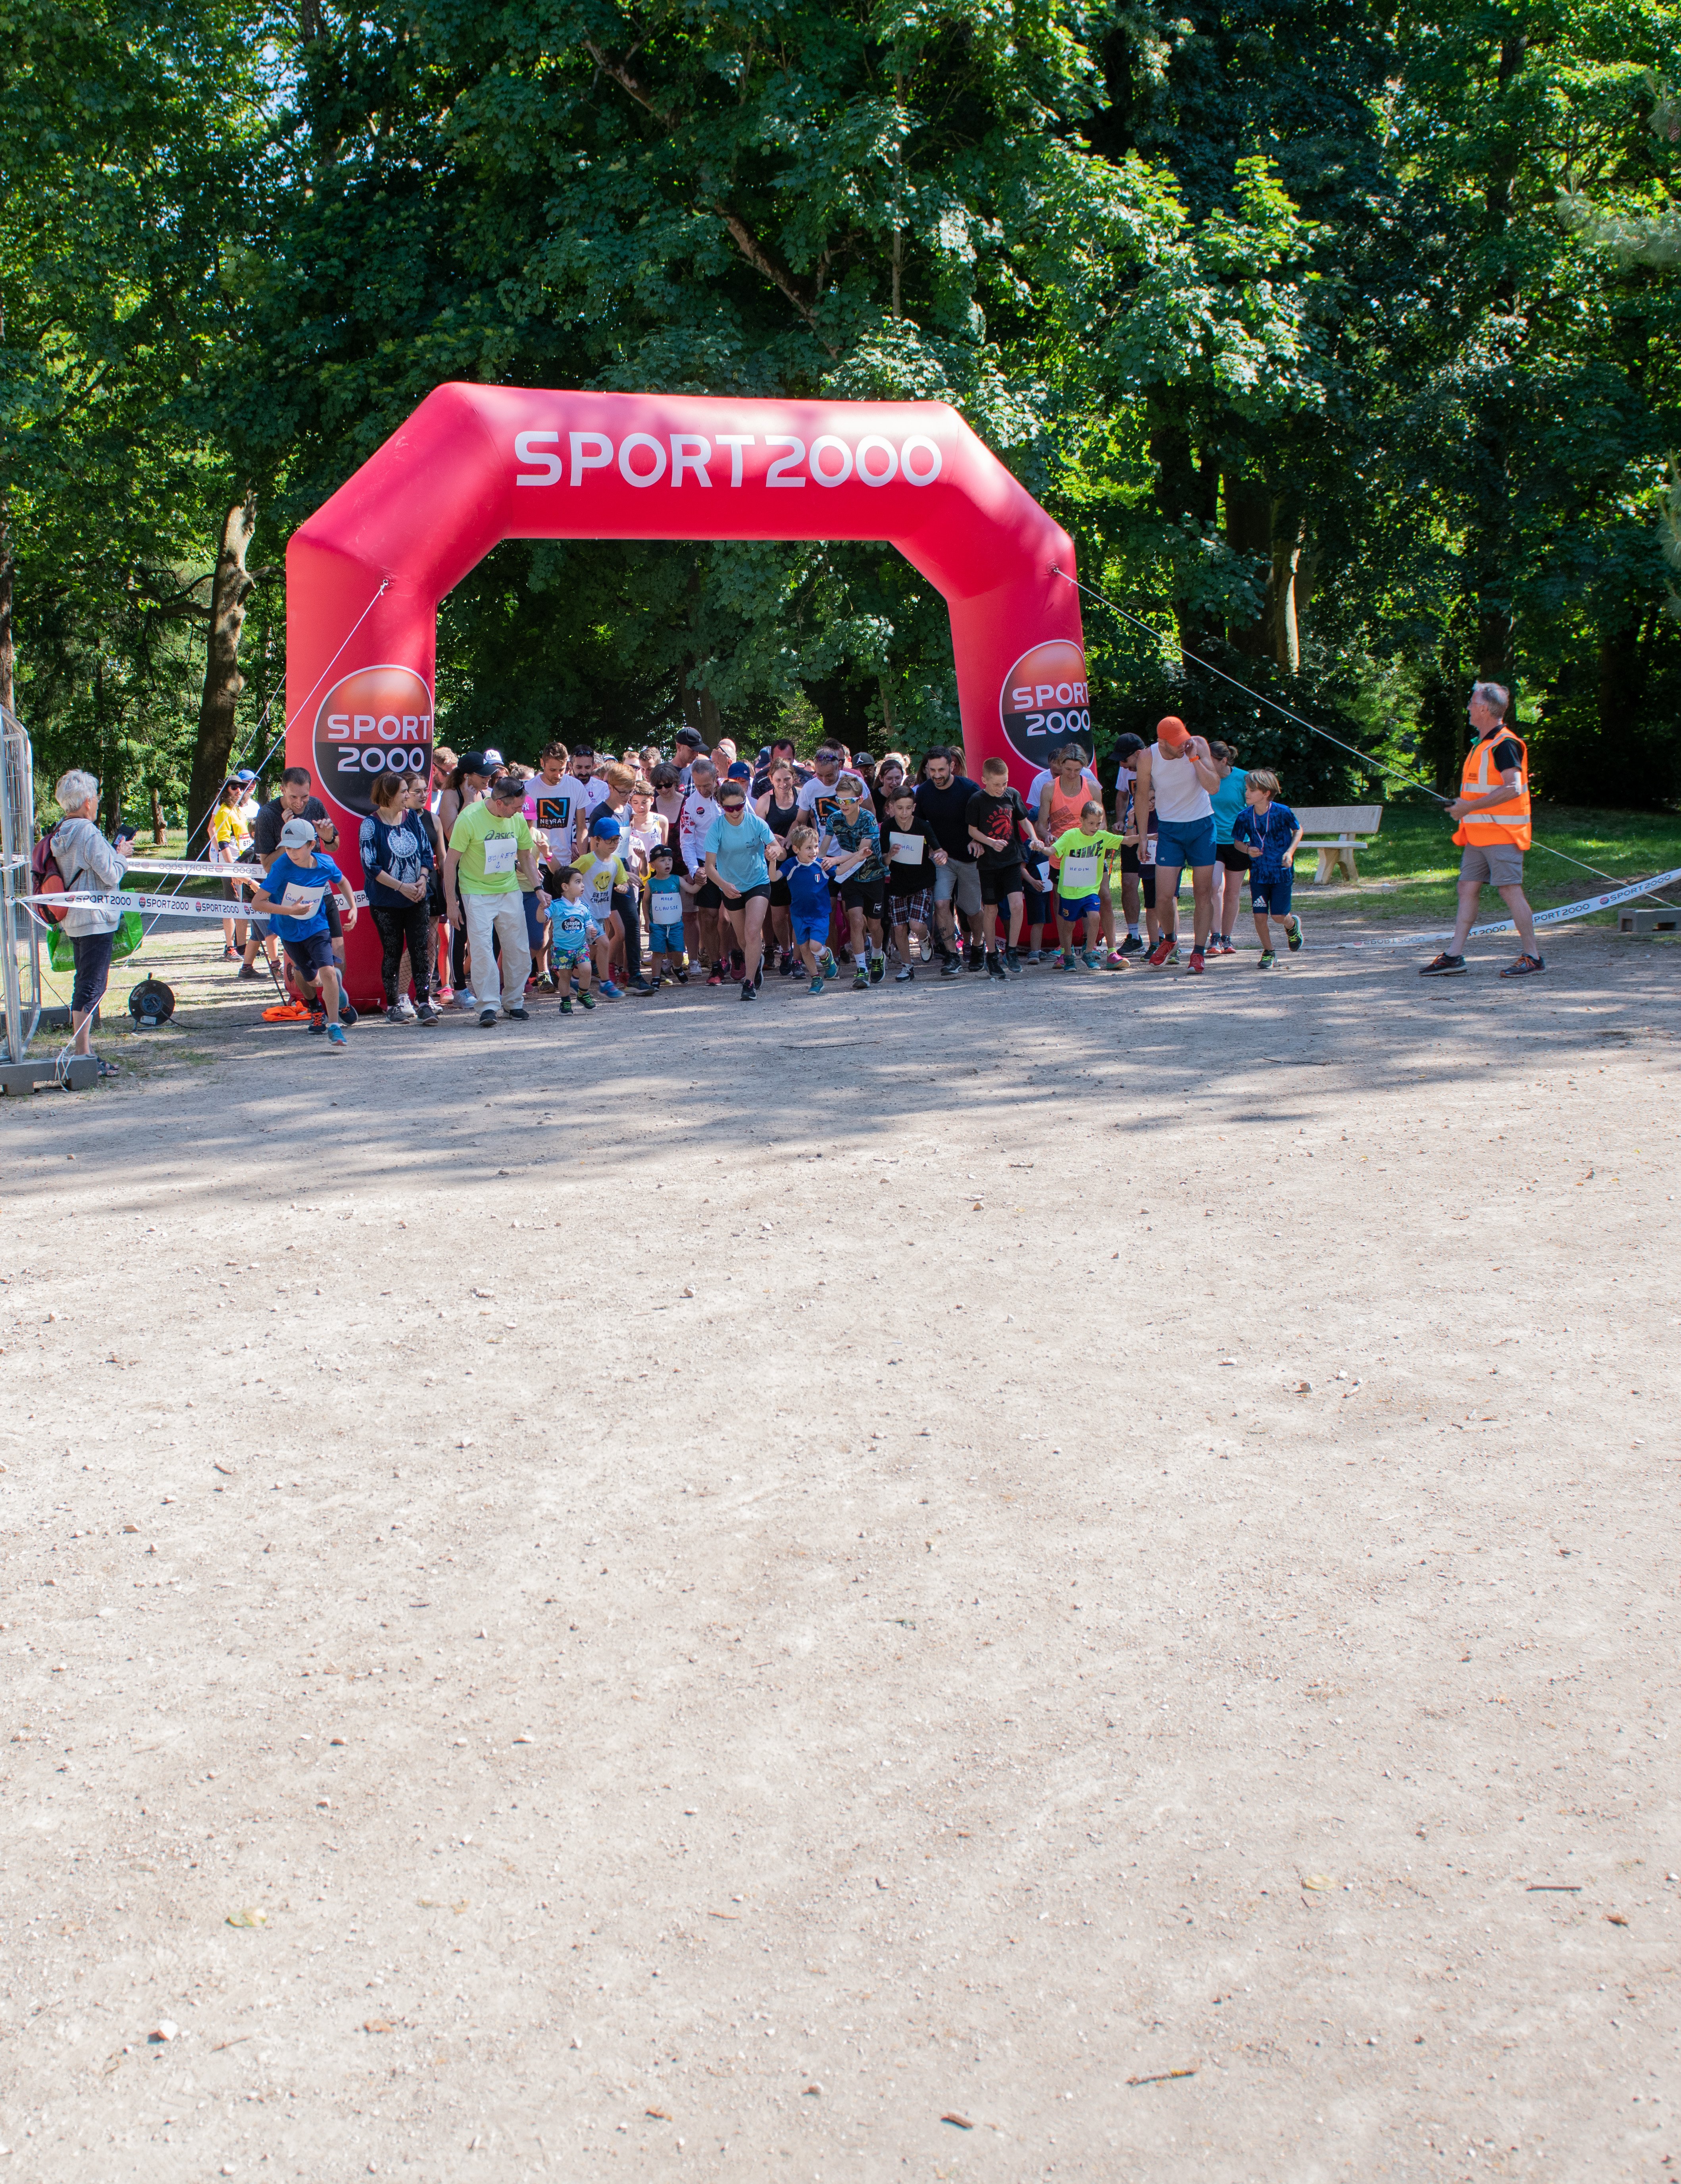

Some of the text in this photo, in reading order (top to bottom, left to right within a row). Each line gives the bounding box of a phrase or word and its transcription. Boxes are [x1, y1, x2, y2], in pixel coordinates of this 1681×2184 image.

[1012, 682, 1089, 710] SPORT
[327, 714, 430, 741] SPORT
[1025, 709, 1091, 737] 2000
[338, 747, 424, 773] 2000
[494, 831, 514, 840] asics
[488, 851, 515, 862] BOIRET
[1069, 839, 1103, 858] NIKE
[1533, 904, 1590, 923] PORT2000
